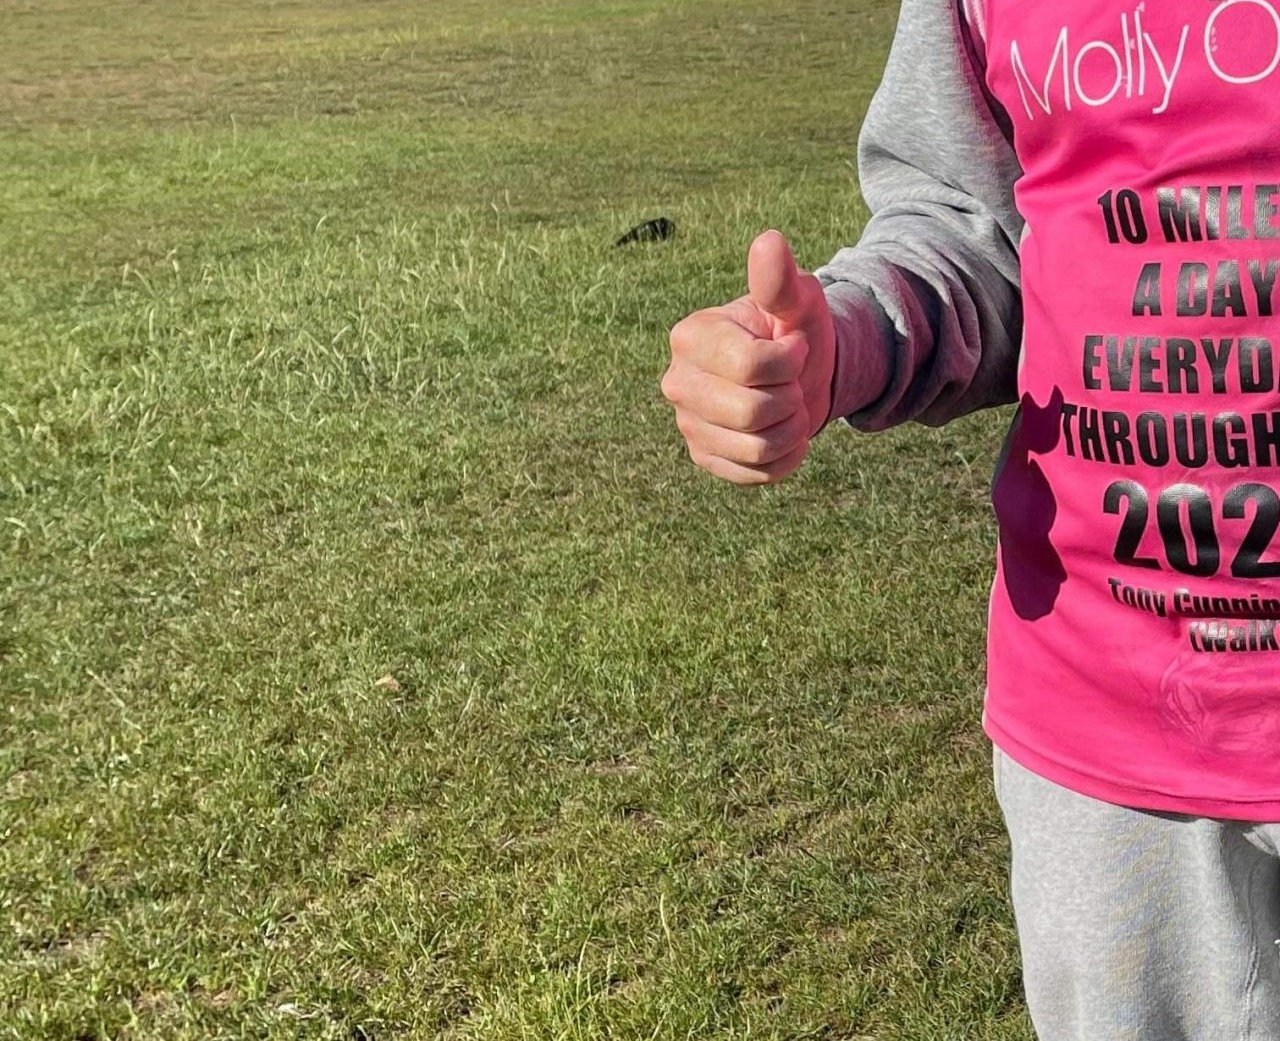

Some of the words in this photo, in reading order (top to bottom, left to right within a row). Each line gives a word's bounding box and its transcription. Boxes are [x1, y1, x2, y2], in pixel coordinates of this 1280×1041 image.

[1010, 6, 1189, 121] Molly
[1098, 188, 1148, 244] 10
[1131, 262, 1162, 317] A
[1176, 259, 1280, 318] DAY
[1108, 577, 1167, 618] Tony
